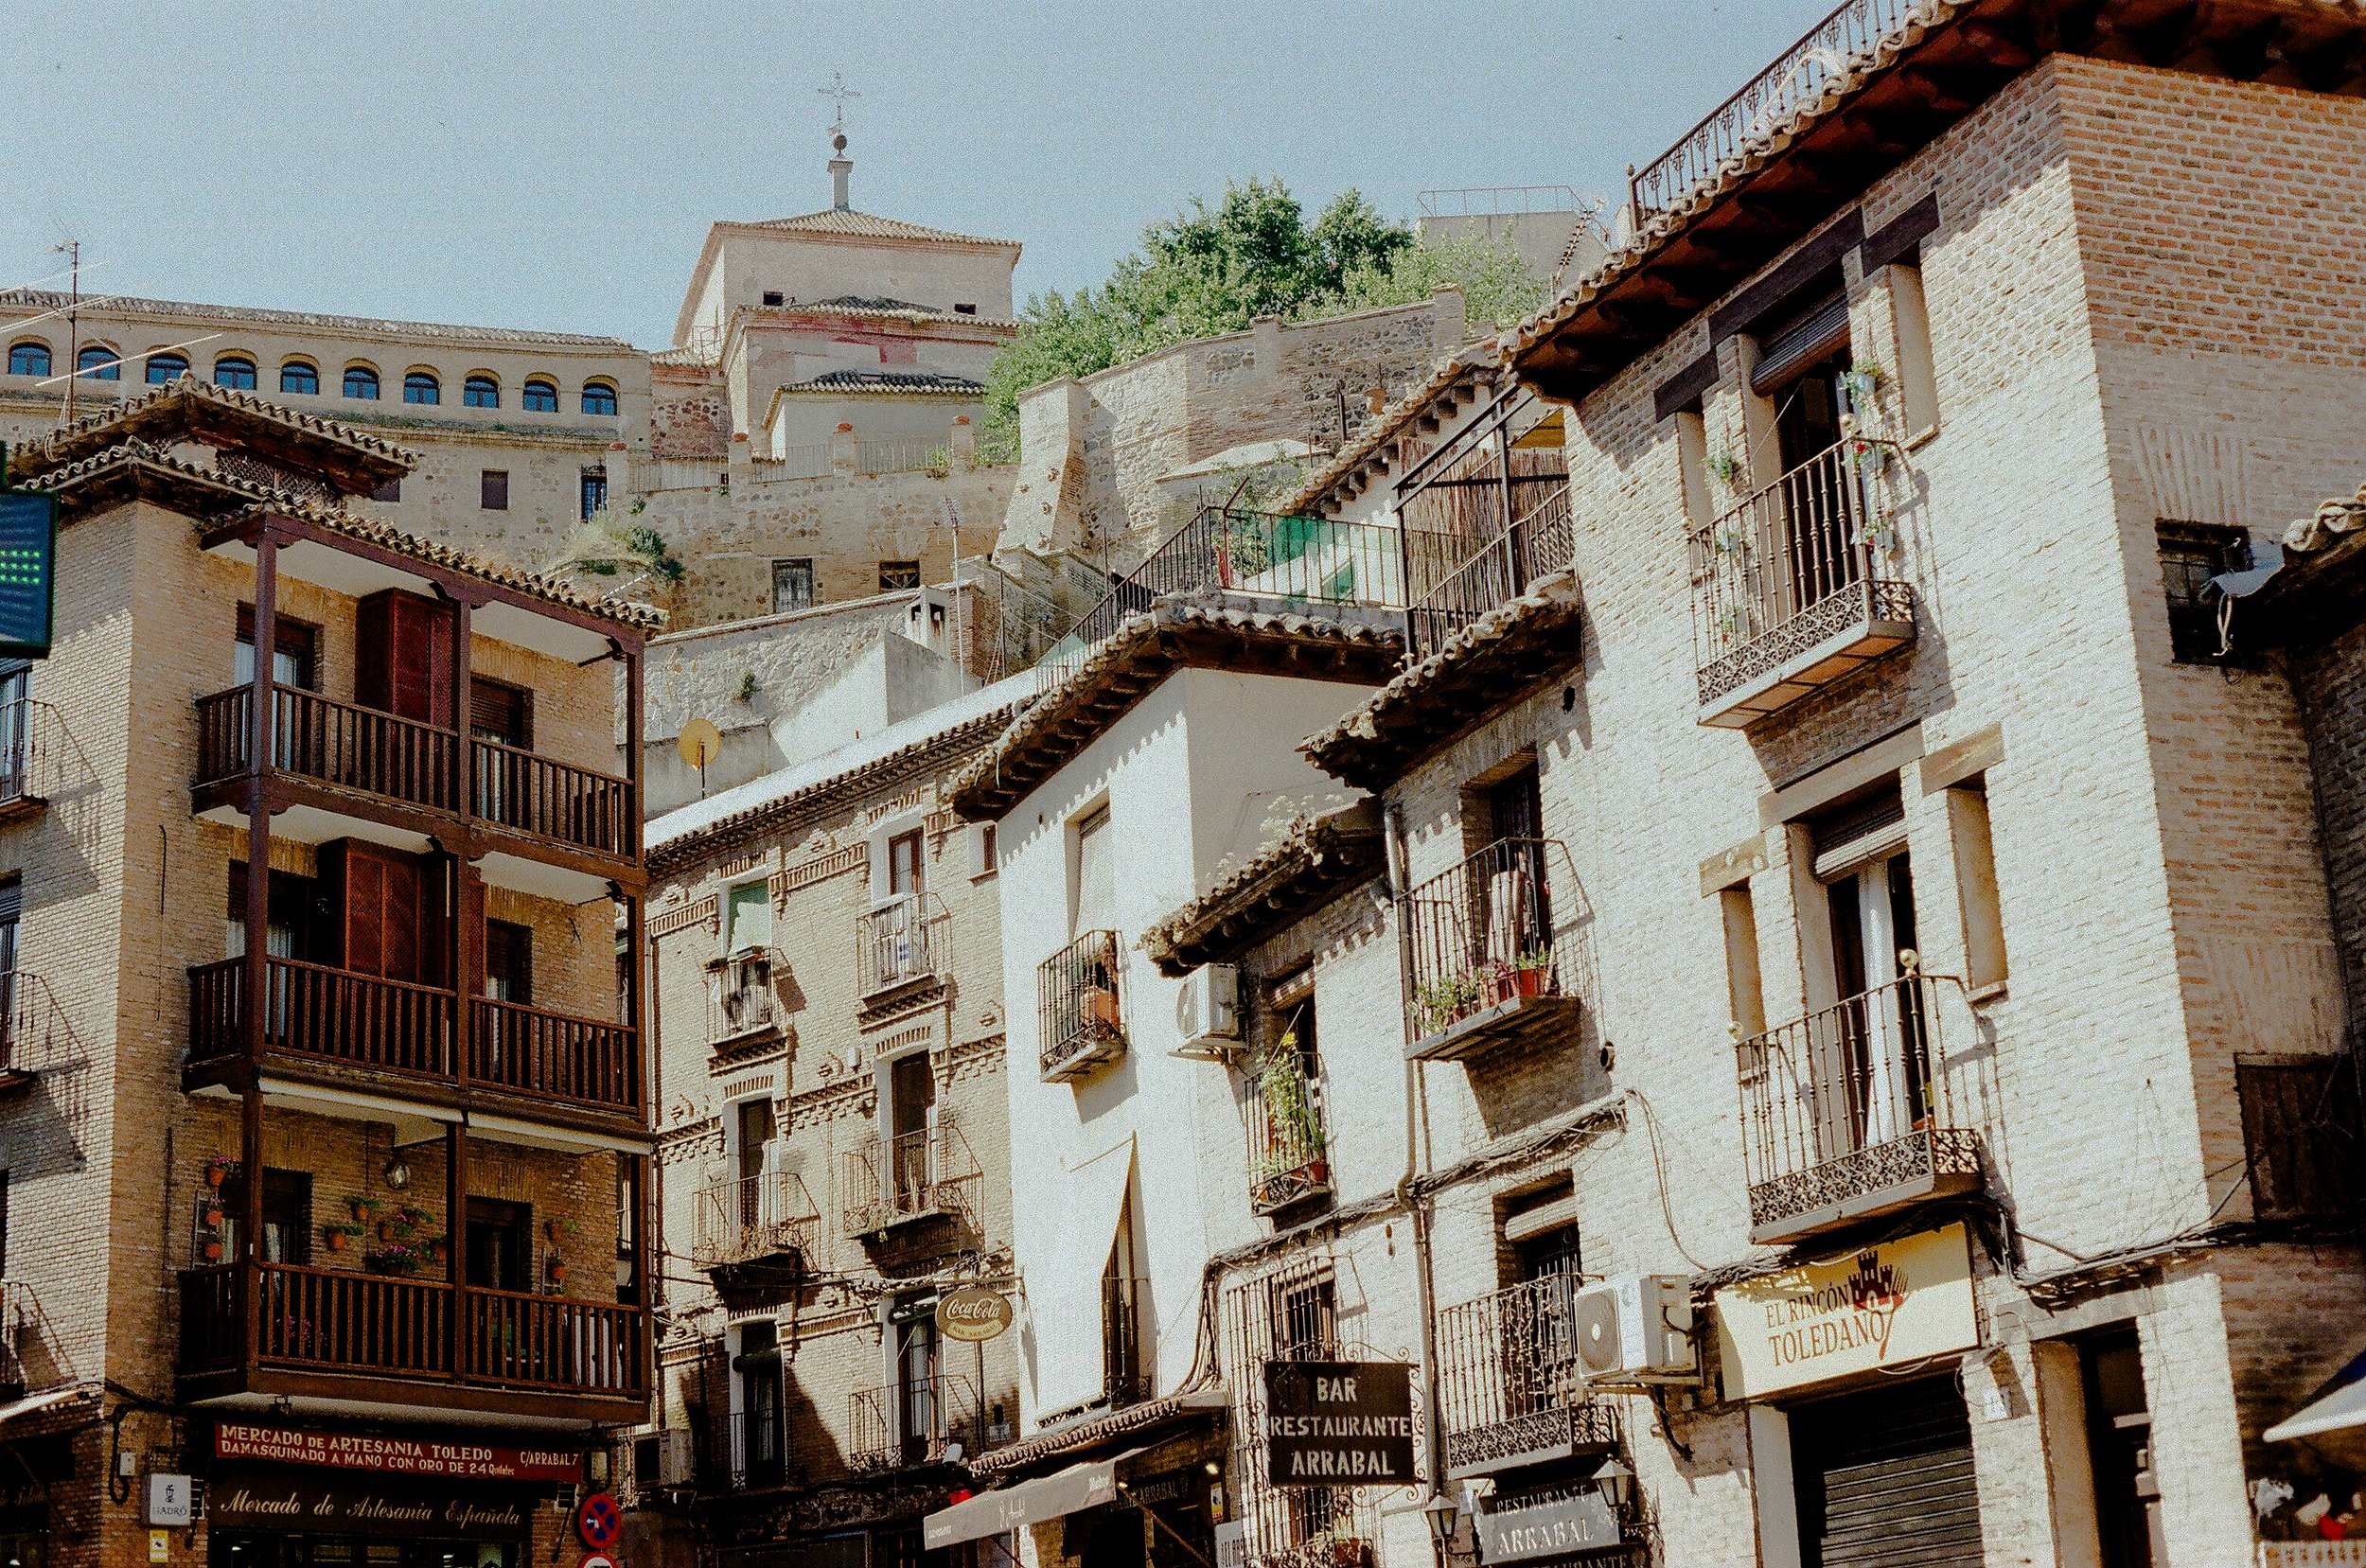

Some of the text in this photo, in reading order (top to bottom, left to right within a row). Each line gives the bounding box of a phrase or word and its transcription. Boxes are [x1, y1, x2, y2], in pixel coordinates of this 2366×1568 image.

[1766, 1282, 1849, 1329] EL RINCÓN
[1769, 1310, 1885, 1366] TOLEDANO
[1316, 1377, 1358, 1402] BAR
[221, 1424, 492, 1461] MERCADO DE ARTESANIA TOLEDO
[1269, 1416, 1412, 1437] RESTAURANTE
[221, 1440, 326, 1463] DAMASQUINADO
[331, 1453, 340, 1464] A
[344, 1453, 382, 1468] MANO
[388, 1456, 415, 1470] CON
[419, 1459, 444, 1471] ORO
[449, 1461, 465, 1473] DE
[469, 1463, 486, 1475] 24
[521, 1451, 579, 1467] C/ARRABAL 7
[1291, 1450, 1396, 1476] ARRABAL
[221, 1489, 521, 1530] Mercado de Artesania Española
[1496, 1484, 1587, 1517] RESTAURANTE
[1498, 1516, 1596, 1556] ARRABAL
